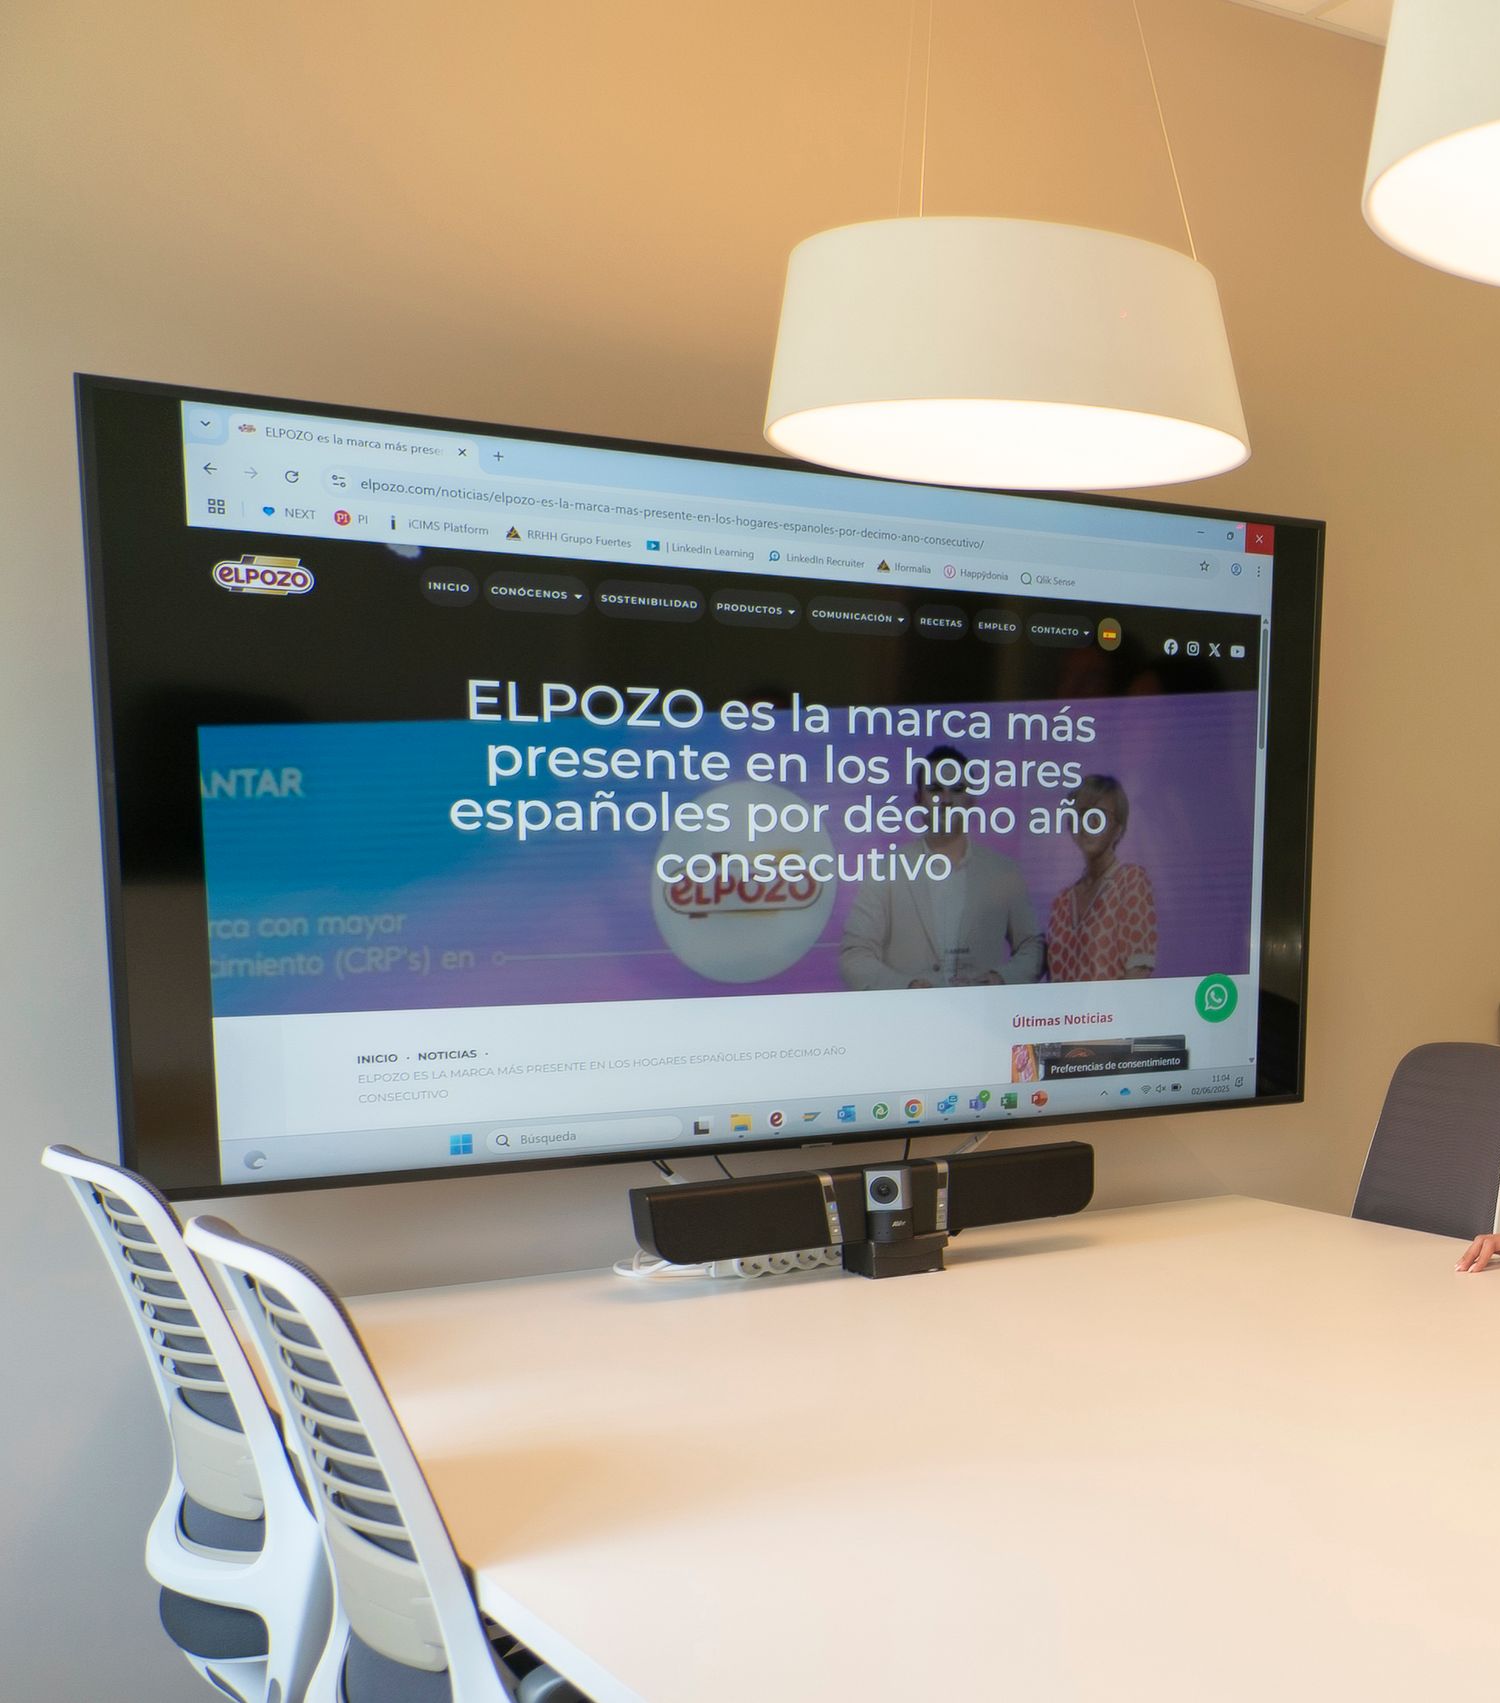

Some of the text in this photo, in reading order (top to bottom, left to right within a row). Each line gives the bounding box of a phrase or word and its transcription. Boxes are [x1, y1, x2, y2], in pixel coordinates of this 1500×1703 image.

[265, 426, 443, 456] ELPOZO es la marca más prese
[284, 507, 316, 520] NEXT
[358, 514, 368, 525] PI
[408, 520, 489, 536] iCIMS Platform
[527, 529, 632, 549] RRHH Grupo Fuertes
[671, 543, 755, 561] LinkedIn Learning
[786, 553, 865, 569] LinkedIn Recruiter
[428, 581, 470, 593] INICIO
[1053, 577, 1076, 588] Sense
[490, 585, 568, 600] CONÓCENOS
[600, 594, 698, 609] SOSTENIBILIDAD
[716, 602, 783, 615] PRODUCTOS
[811, 609, 893, 623] COMUNICACIÓN
[920, 617, 963, 628] RECETAS
[978, 621, 1017, 632] EMPLEO
[1031, 625, 1079, 636] CONTACTO
[467, 679, 1097, 743] ELPOZO es la marca más
[487, 744, 1083, 796] presente en los hogares
[449, 790, 1107, 843] españoles por décimo año
[655, 843, 953, 886] consecutivo
[258, 915, 309, 938] con
[317, 912, 408, 940] mayor
[440, 951, 475, 970] en
[1012, 1012, 1113, 1029] Últimas Noticias
[357, 1049, 478, 1065] INICIO NOTICIAS
[358, 1045, 847, 1084] ELPOZO ES LA MARCA MÁS PRESENTE EN LOS HOGARES ESPAÑOLES POR DÉCIMO AÑO
[1050, 1056, 1181, 1075] Preferencias de consentimiento
[1212, 1073, 1231, 1083] 11:04
[358, 1089, 449, 1104] CONSECUTIVO
[520, 1130, 577, 1145] Búsqueda
